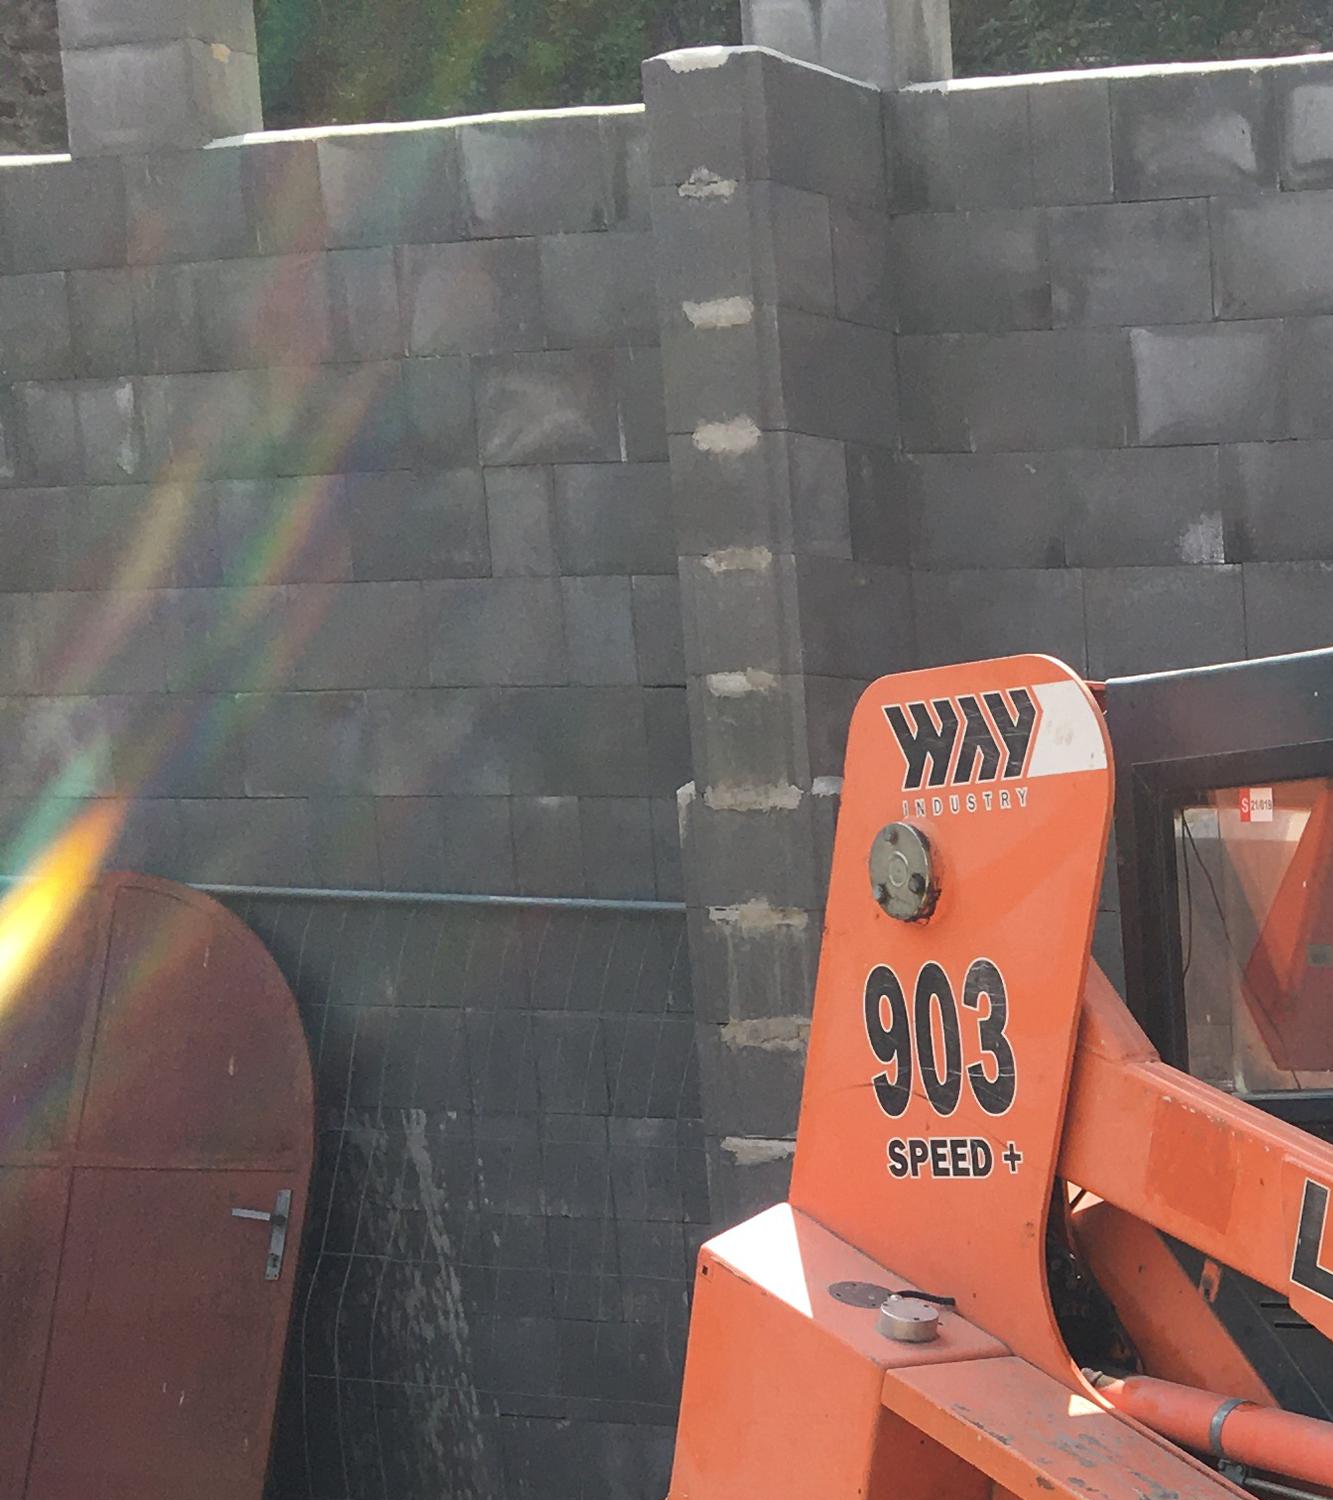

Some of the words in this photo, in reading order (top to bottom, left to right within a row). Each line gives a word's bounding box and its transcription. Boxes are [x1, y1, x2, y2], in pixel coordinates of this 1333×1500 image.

[882, 686, 1042, 791] WAY
[903, 786, 1028, 816] INDUSTRY
[863, 957, 1016, 1118] 903
[887, 1136, 994, 1179] SPEED
